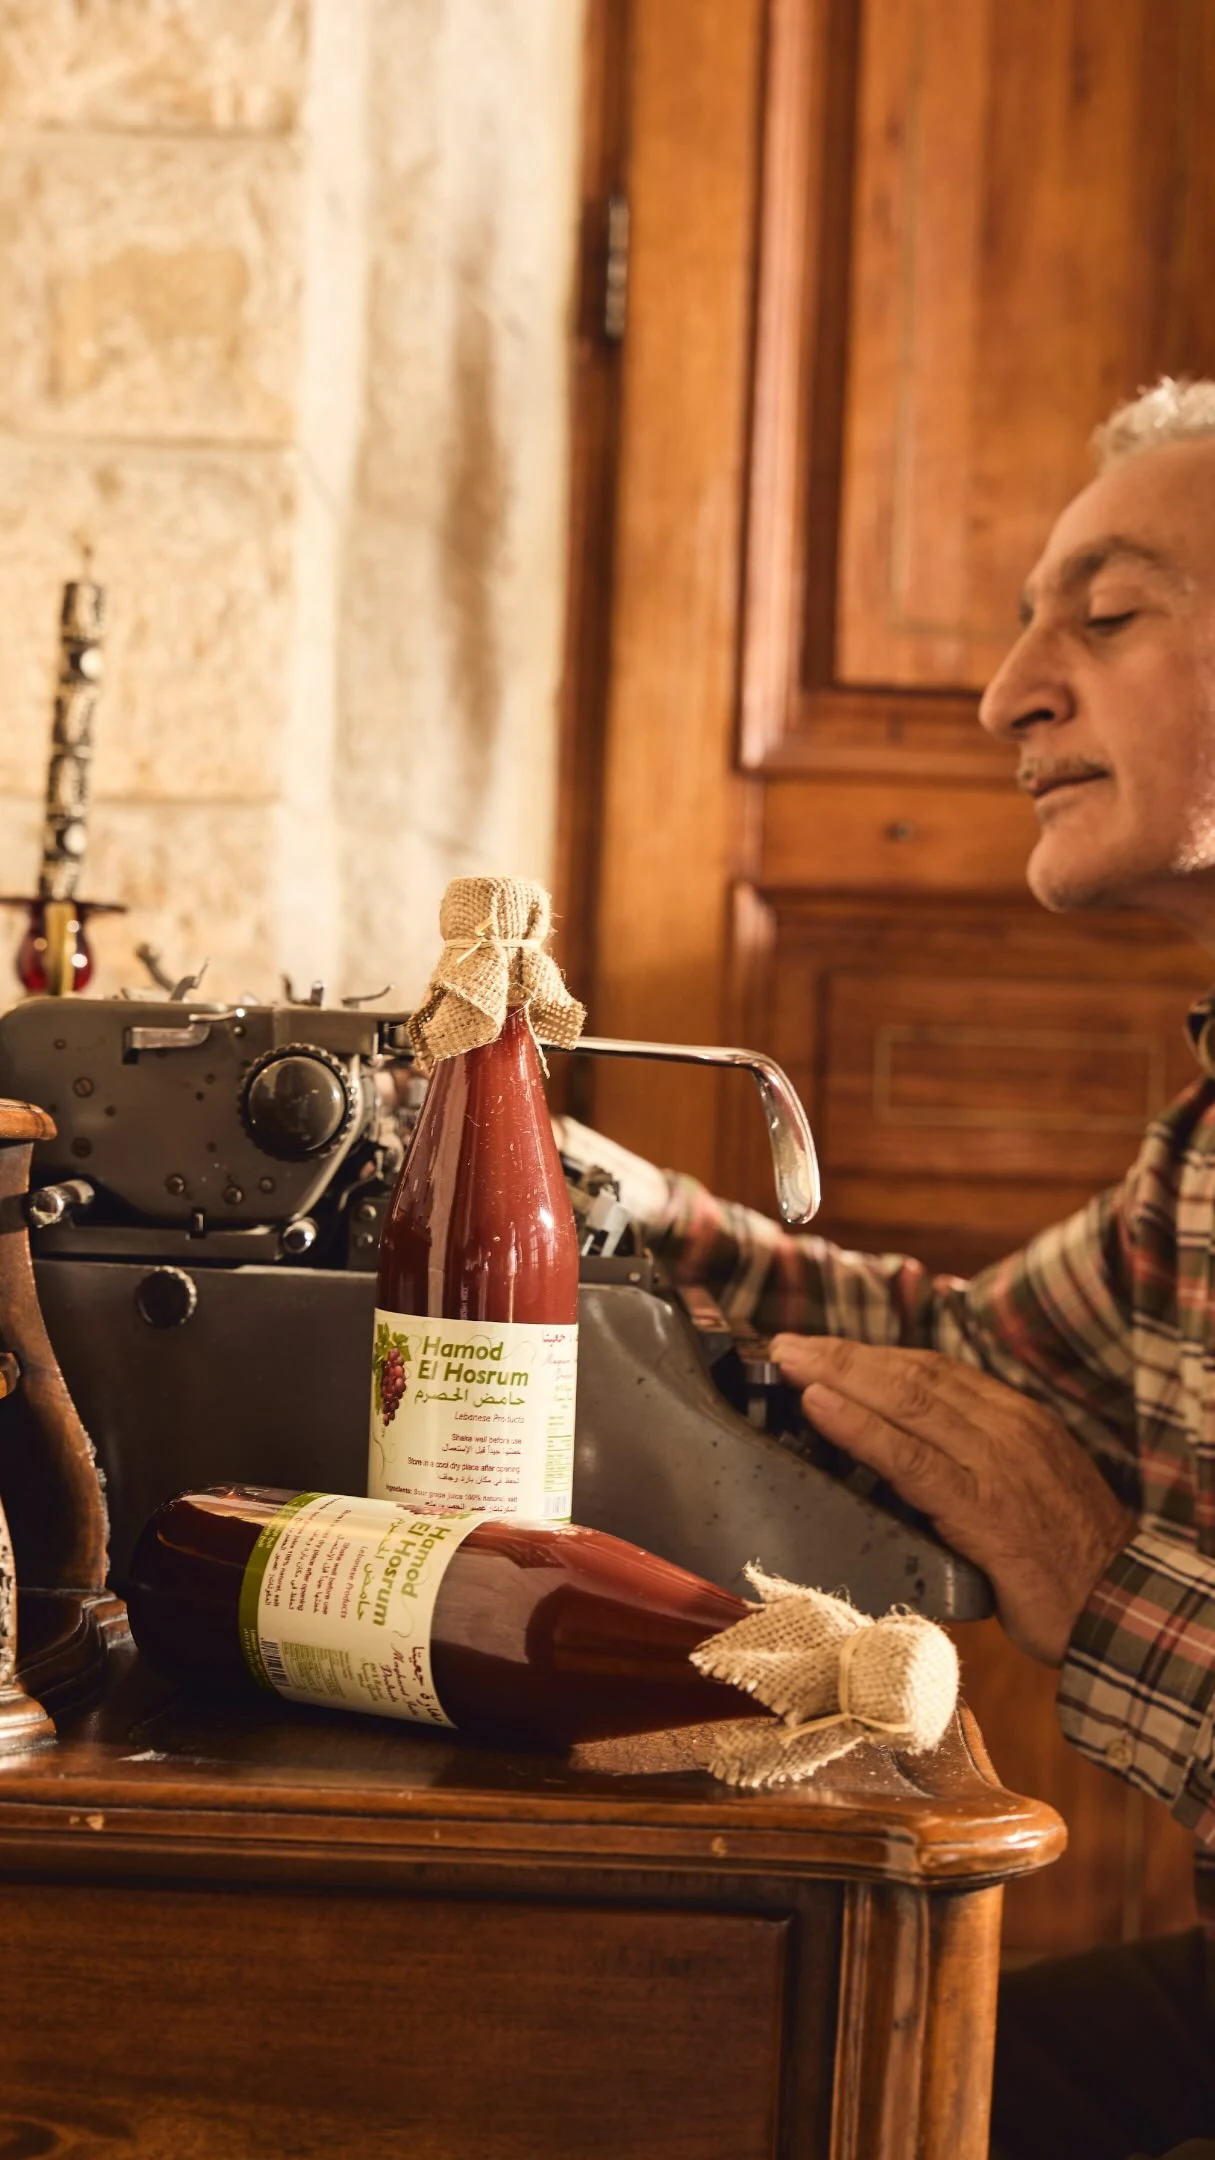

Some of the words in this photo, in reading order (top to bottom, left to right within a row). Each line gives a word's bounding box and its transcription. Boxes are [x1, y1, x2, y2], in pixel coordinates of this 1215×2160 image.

[422, 1335, 504, 1361] Hamod
[418, 1359, 438, 1381] El
[444, 1361, 529, 1387] Hosrum
[414, 1387, 468, 1405] الحصرم
[473, 1390, 525, 1408] حامض
[454, 1411, 491, 1422] Lebanese
[407, 1521, 431, 1536] El
[400, 1526, 452, 1599] Hamod
[356, 1562, 375, 1621] حامض
[372, 1539, 417, 1626] Hosrum
[340, 1582, 354, 1619] Products
[408, 1646, 425, 1687] جعيتا
